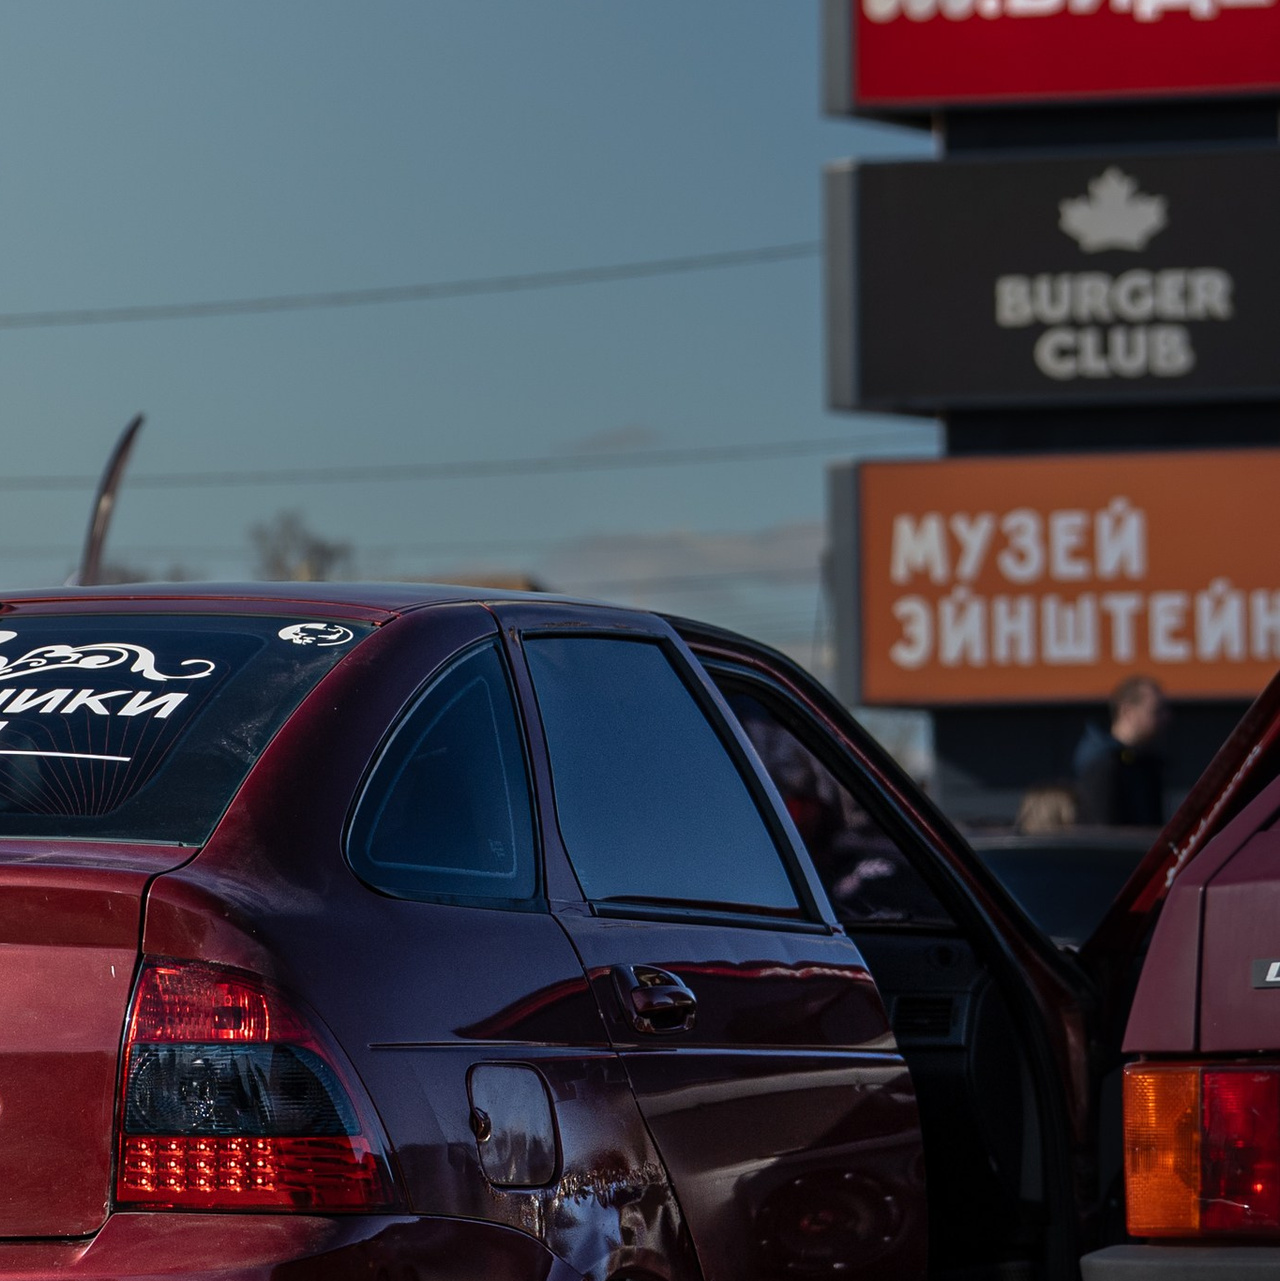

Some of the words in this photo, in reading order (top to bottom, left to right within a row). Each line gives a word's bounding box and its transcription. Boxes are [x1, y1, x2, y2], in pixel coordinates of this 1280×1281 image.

[995, 268, 1232, 327] BURGER
[1034, 324, 1195, 379] CLUB
[891, 496, 1147, 584] МУЗЕЙ
